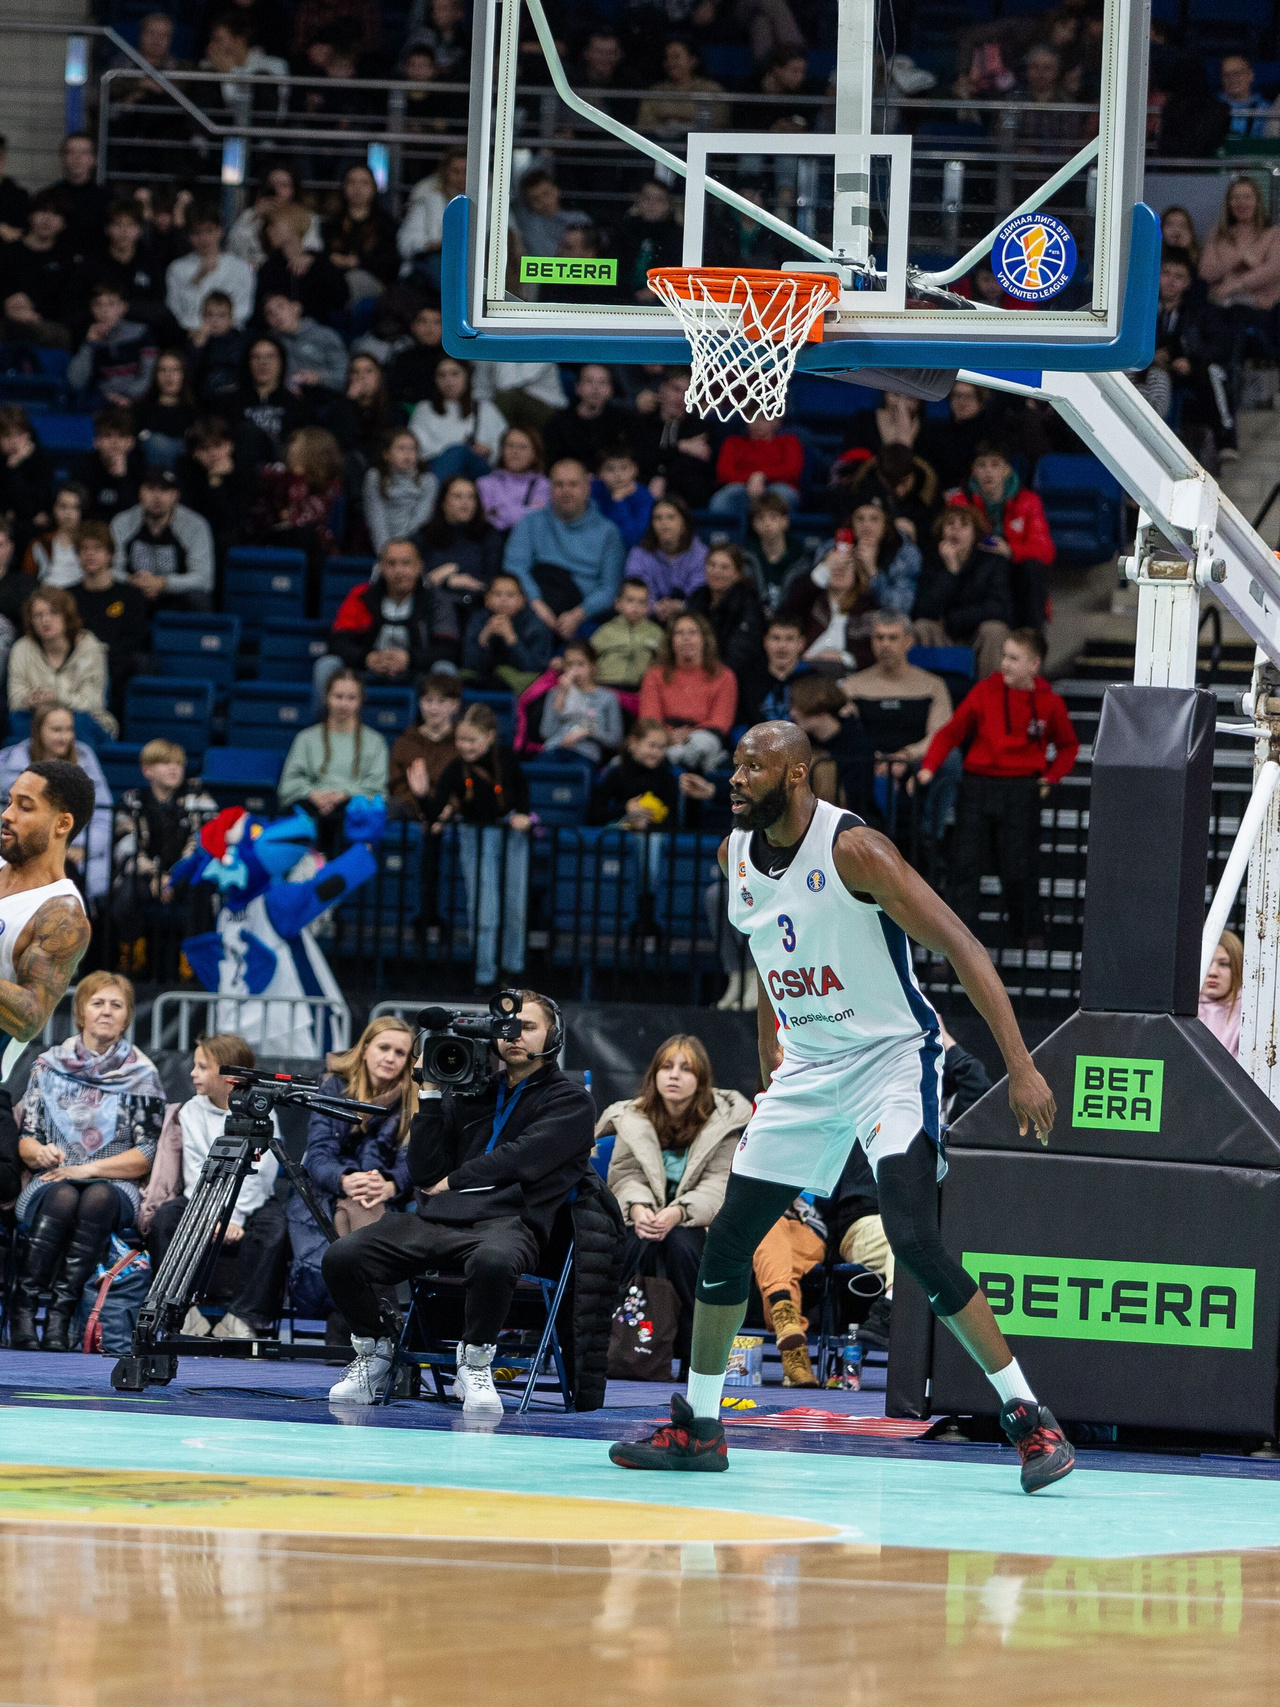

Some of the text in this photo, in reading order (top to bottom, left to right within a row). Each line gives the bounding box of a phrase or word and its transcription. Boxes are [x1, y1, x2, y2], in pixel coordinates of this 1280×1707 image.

[1000, 215, 1070, 242] ЕДИНАЯ ЛИГА ВТБ
[997, 271, 1068, 299] VTB UNITED LEAGUE
[777, 914, 797, 953] 3
[768, 965, 845, 1001] CSKA
[1084, 1066, 1154, 1093] BET
